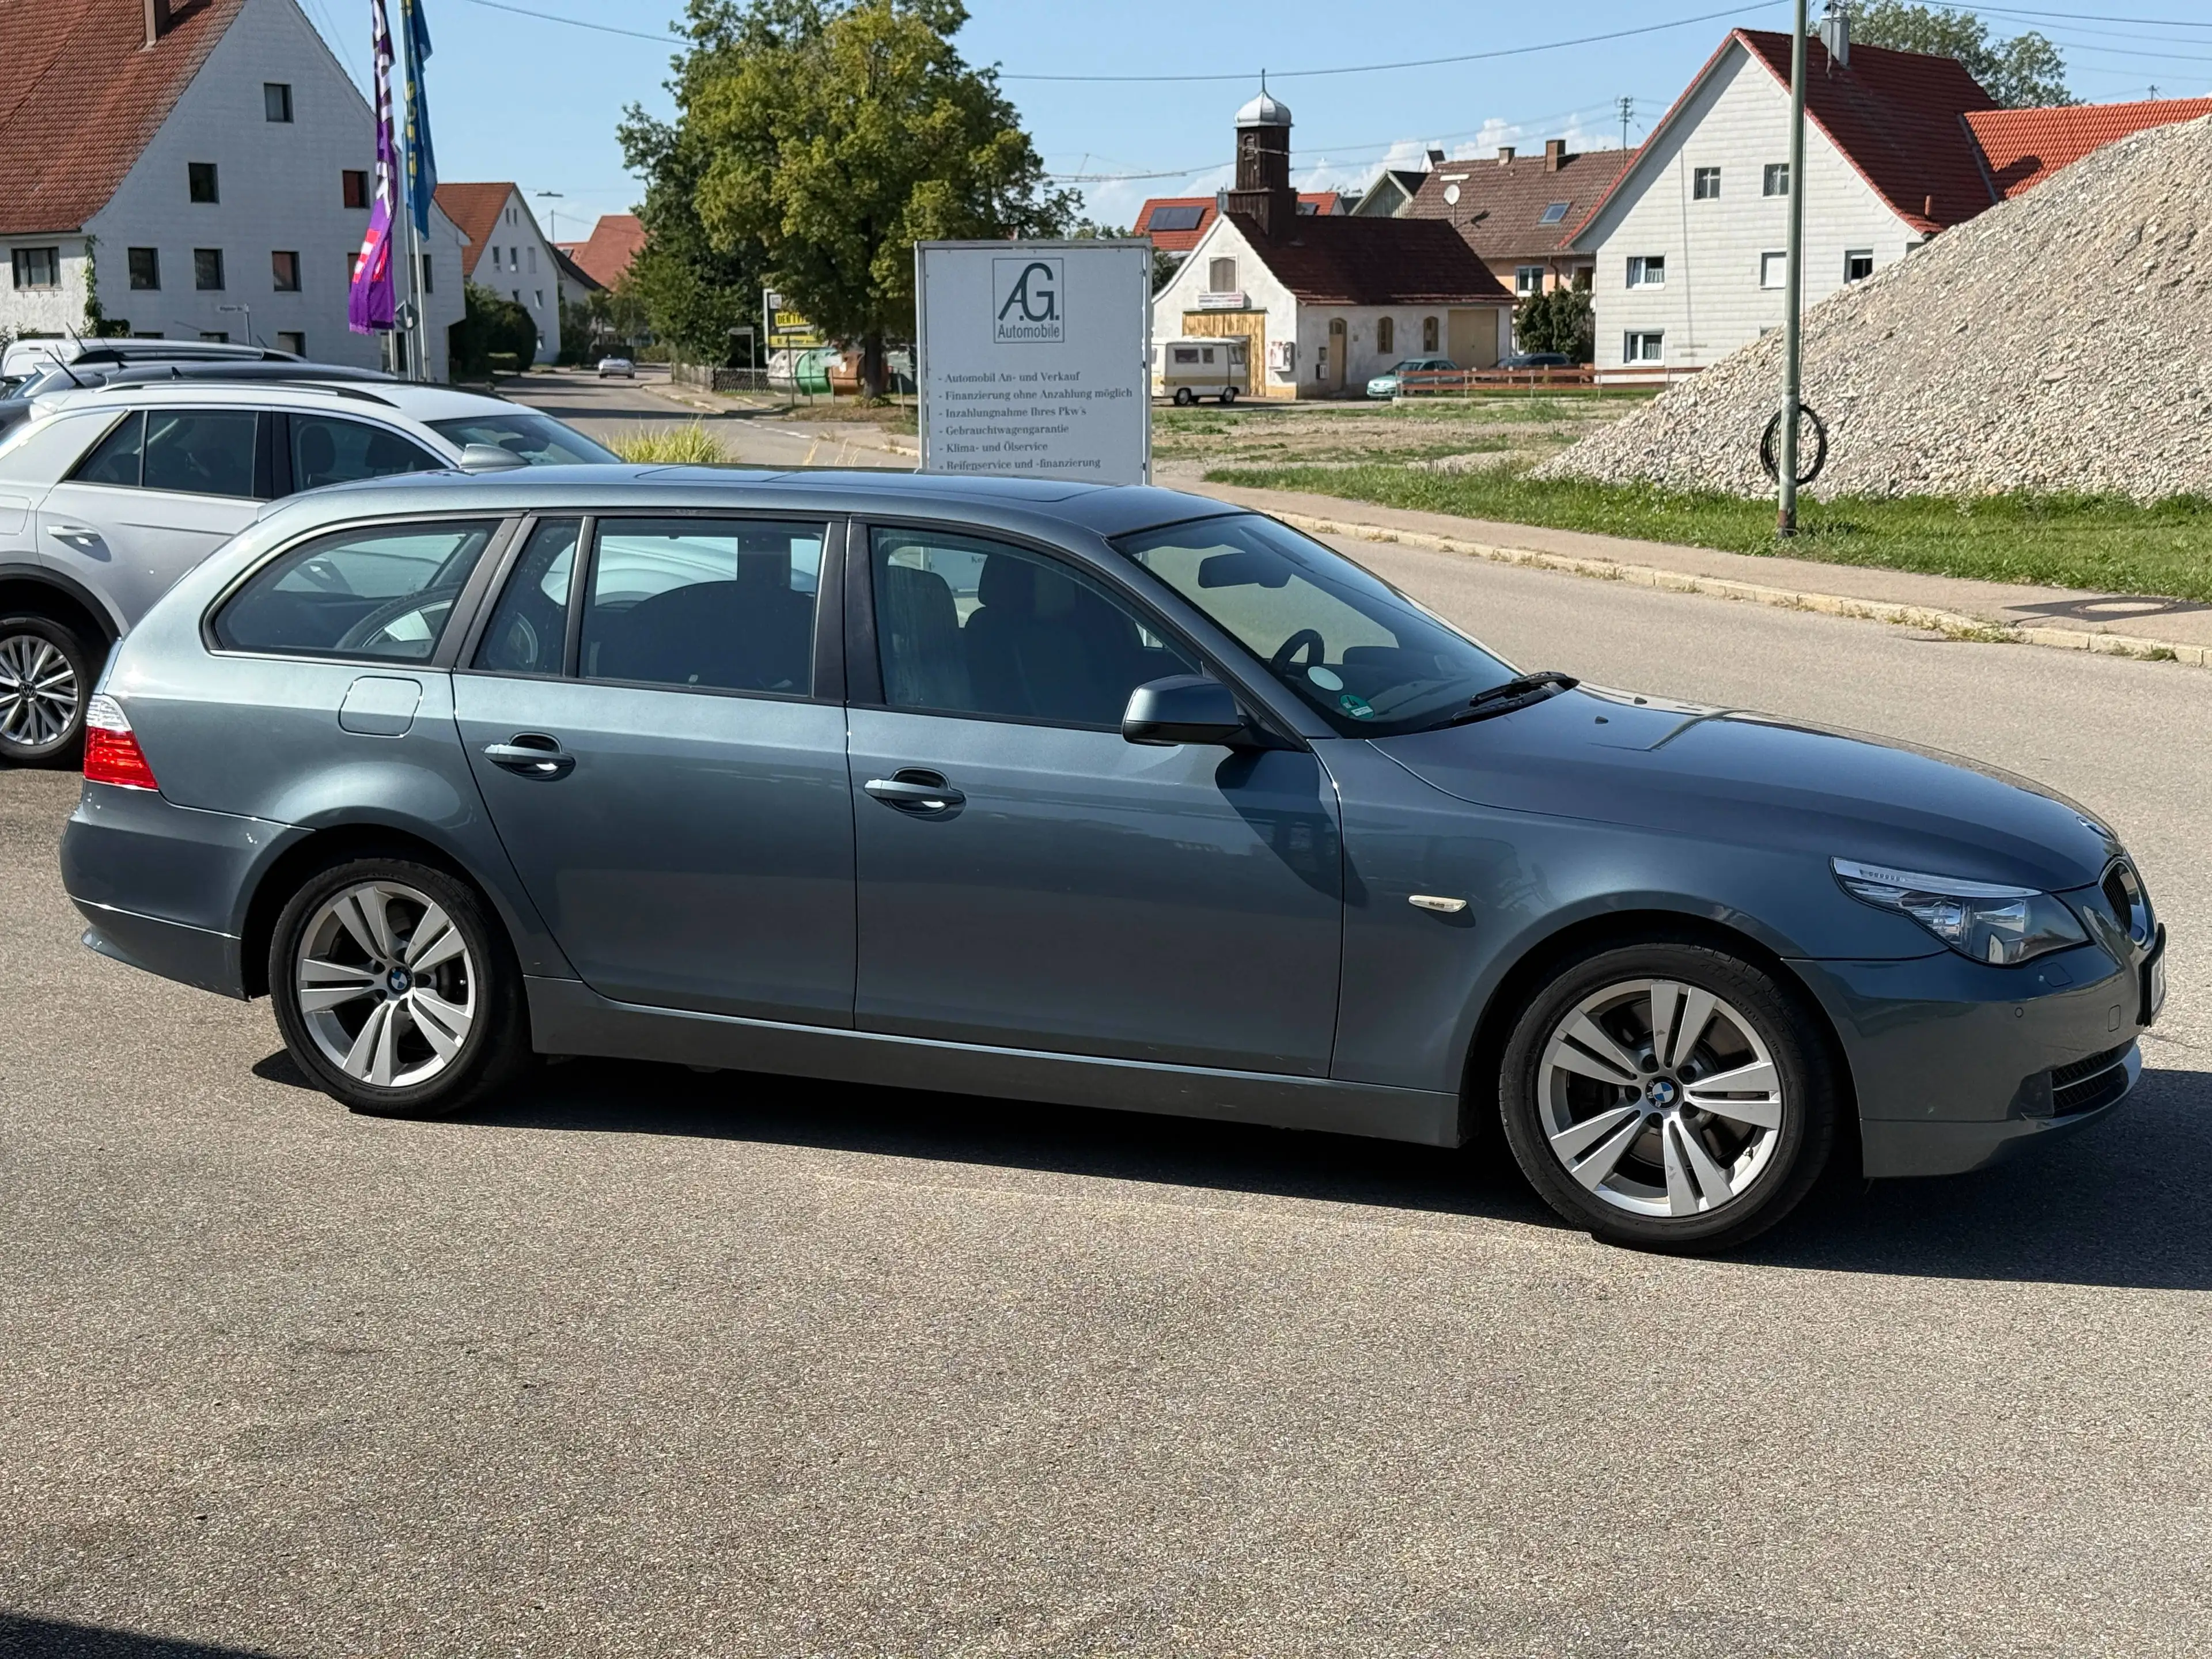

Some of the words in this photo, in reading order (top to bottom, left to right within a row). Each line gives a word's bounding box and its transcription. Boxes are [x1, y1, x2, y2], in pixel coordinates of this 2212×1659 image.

[997, 324, 1060, 338] Automobile
[945, 373, 996, 383] Automobil
[998, 373, 1016, 382] An-
[1019, 372, 1037, 381] und
[1040, 371, 1081, 381] Verkauf
[945, 390, 1011, 401] Finanzierung
[1013, 389, 1037, 399] ohne
[1040, 389, 1092, 400] Anzahlung
[1094, 387, 1133, 399] möglich
[946, 408, 1028, 420] Inzahlungnahme
[1031, 407, 1056, 416] Ihres
[946, 424, 1069, 436] Gebrauchtwagengarantie
[946, 443, 979, 453] Klima-
[982, 442, 1001, 452] und
[1003, 440, 1048, 452] Ölservice
[946, 460, 1012, 471] Reifenservice
[1014, 459, 1033, 469] und
[1036, 458, 1101, 469] -finanzierung
